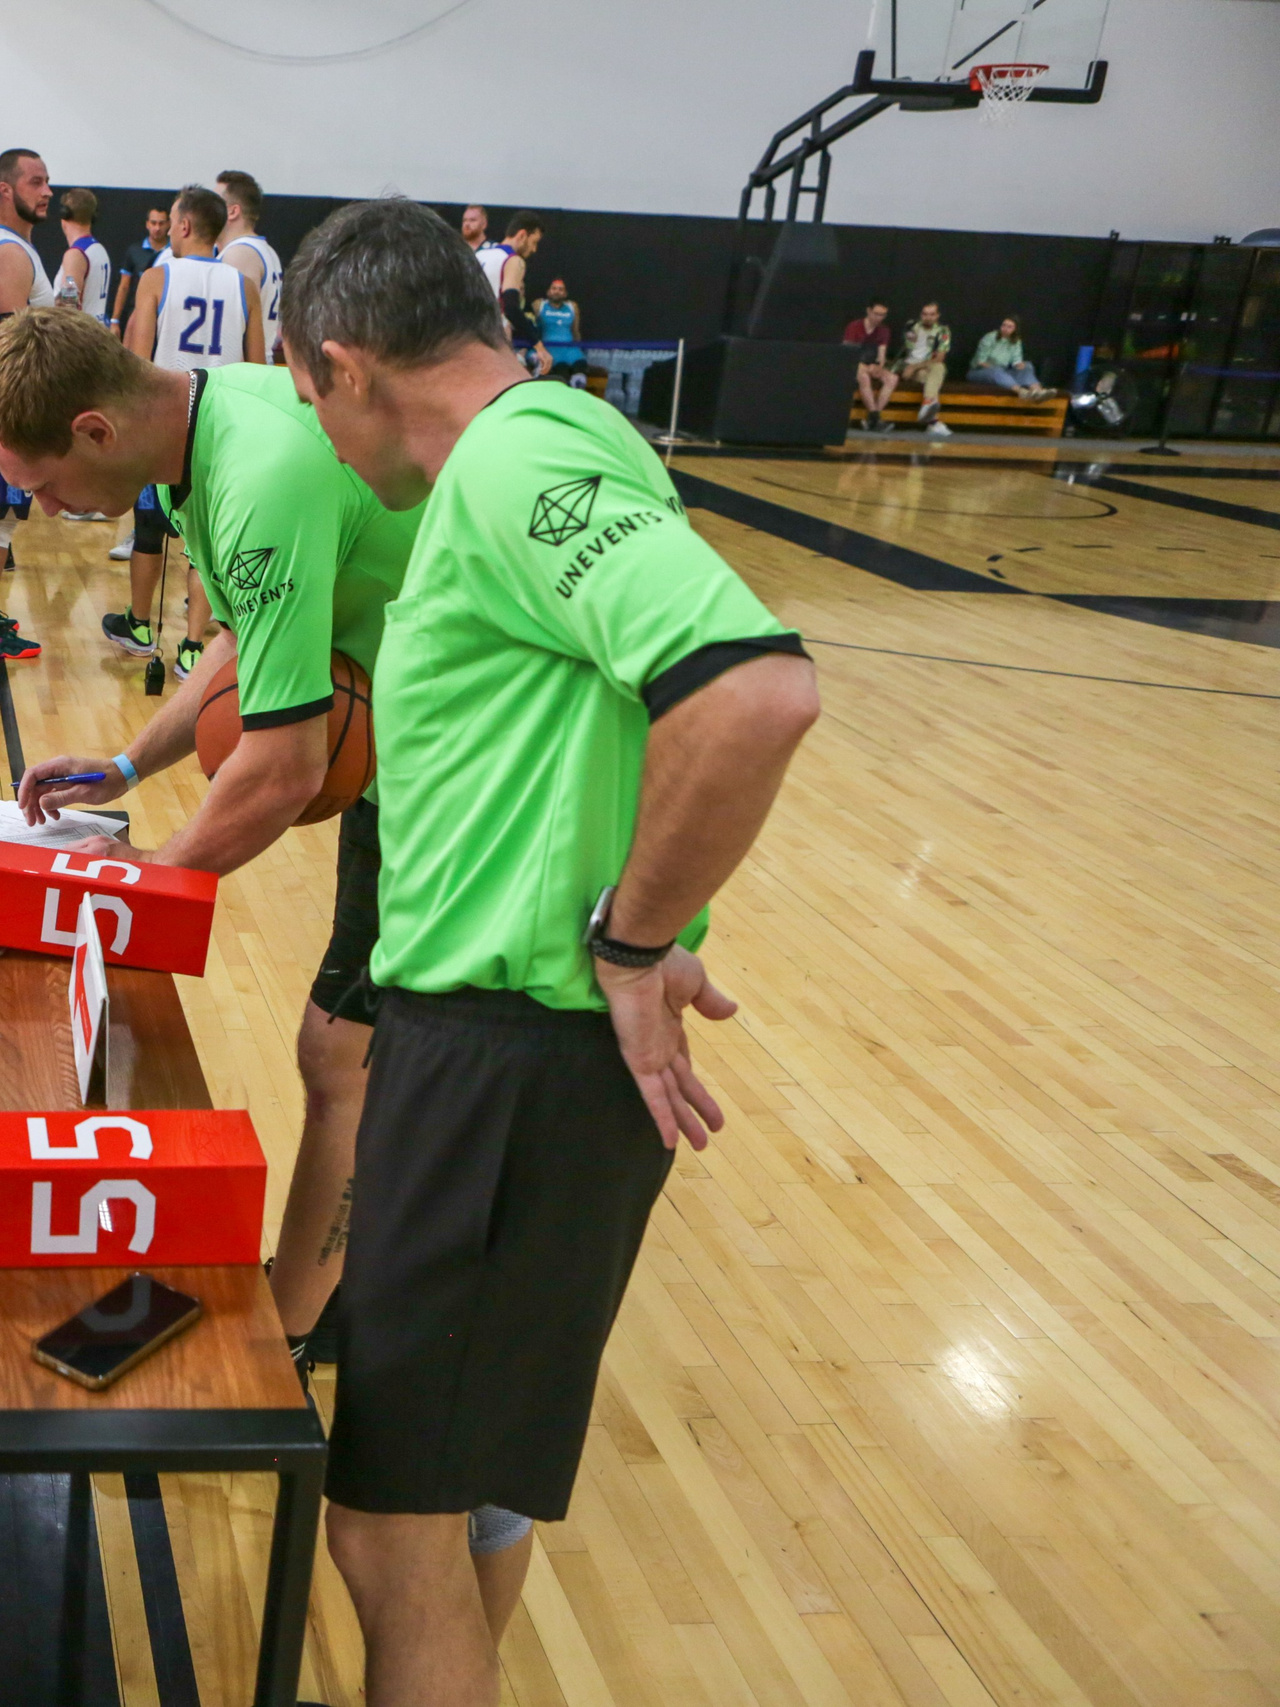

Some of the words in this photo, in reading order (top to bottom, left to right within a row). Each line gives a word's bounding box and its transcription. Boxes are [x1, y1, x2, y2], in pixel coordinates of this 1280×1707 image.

[178, 295, 224, 356] 21
[555, 511, 662, 599] UNEVENTS
[50, 852, 142, 885] 5
[40, 887, 133, 956] 5
[26, 1116, 154, 1160] 5
[30, 1179, 157, 1254] 5
